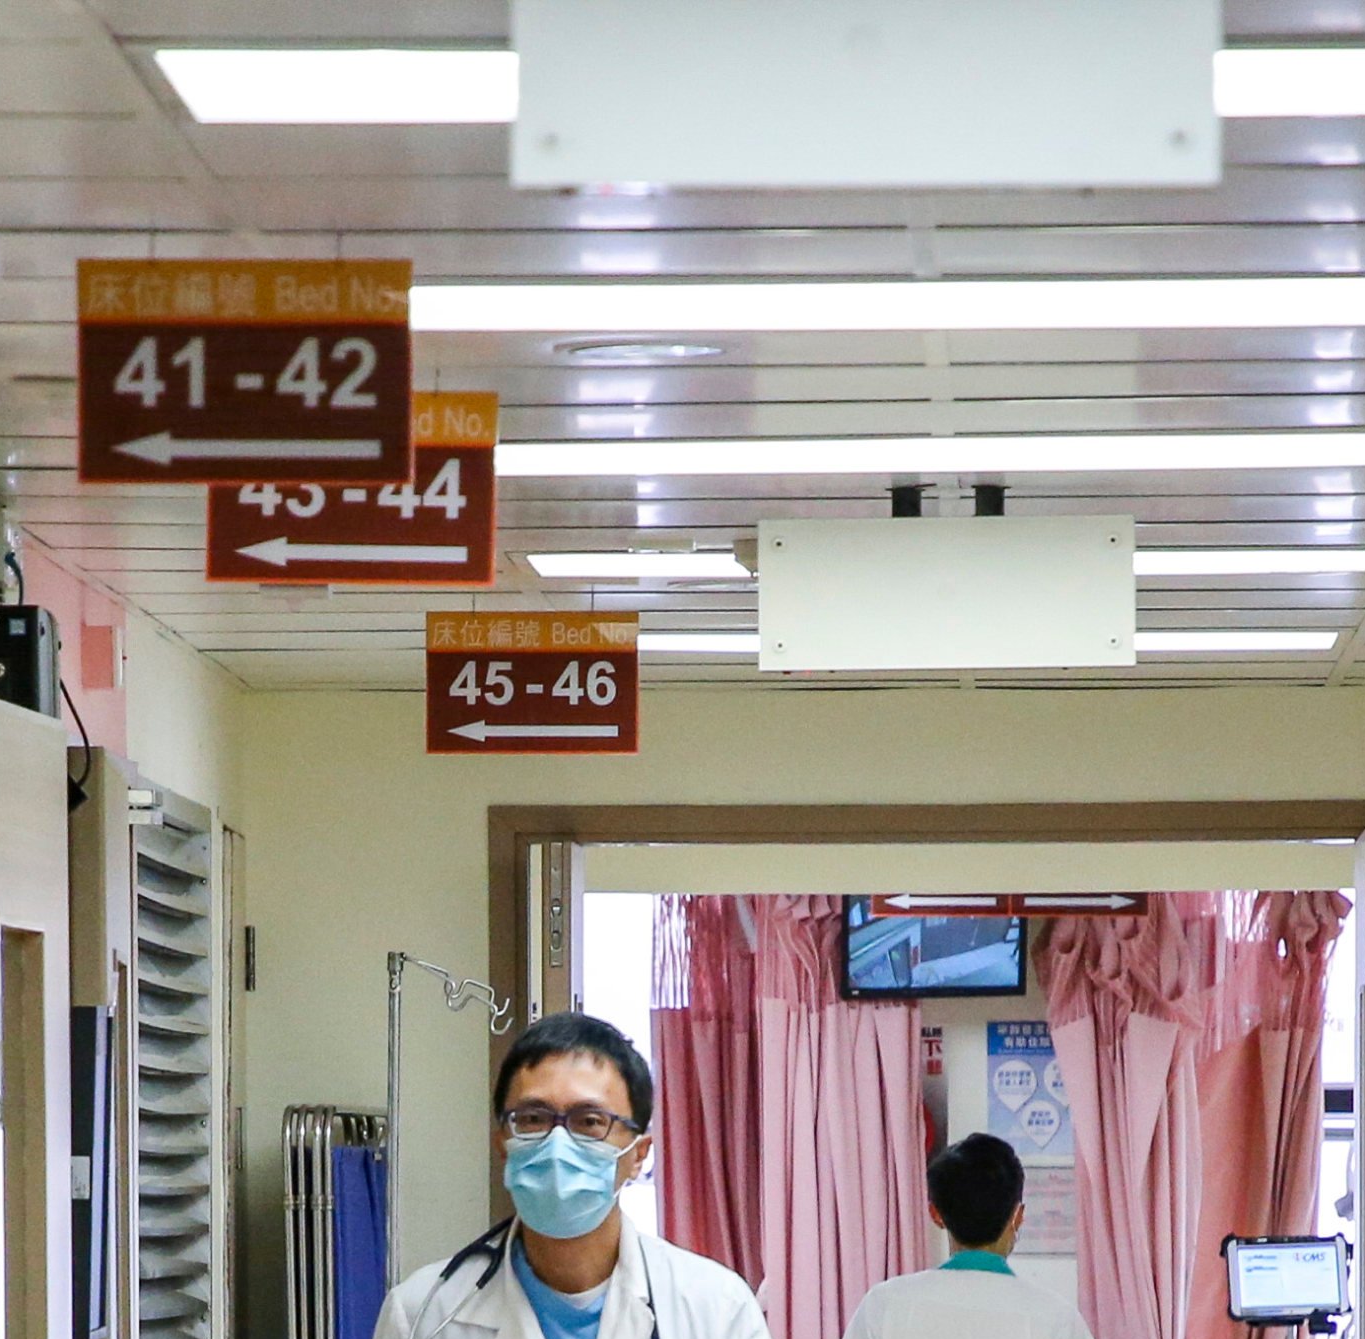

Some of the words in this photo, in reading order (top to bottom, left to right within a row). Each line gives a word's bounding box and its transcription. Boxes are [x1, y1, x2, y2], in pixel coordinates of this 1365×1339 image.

[274, 274, 338, 313] Bed
[443, 406, 490, 438] No.
[435, 619, 540, 648] 床位編號
[552, 621, 591, 645] Bed
